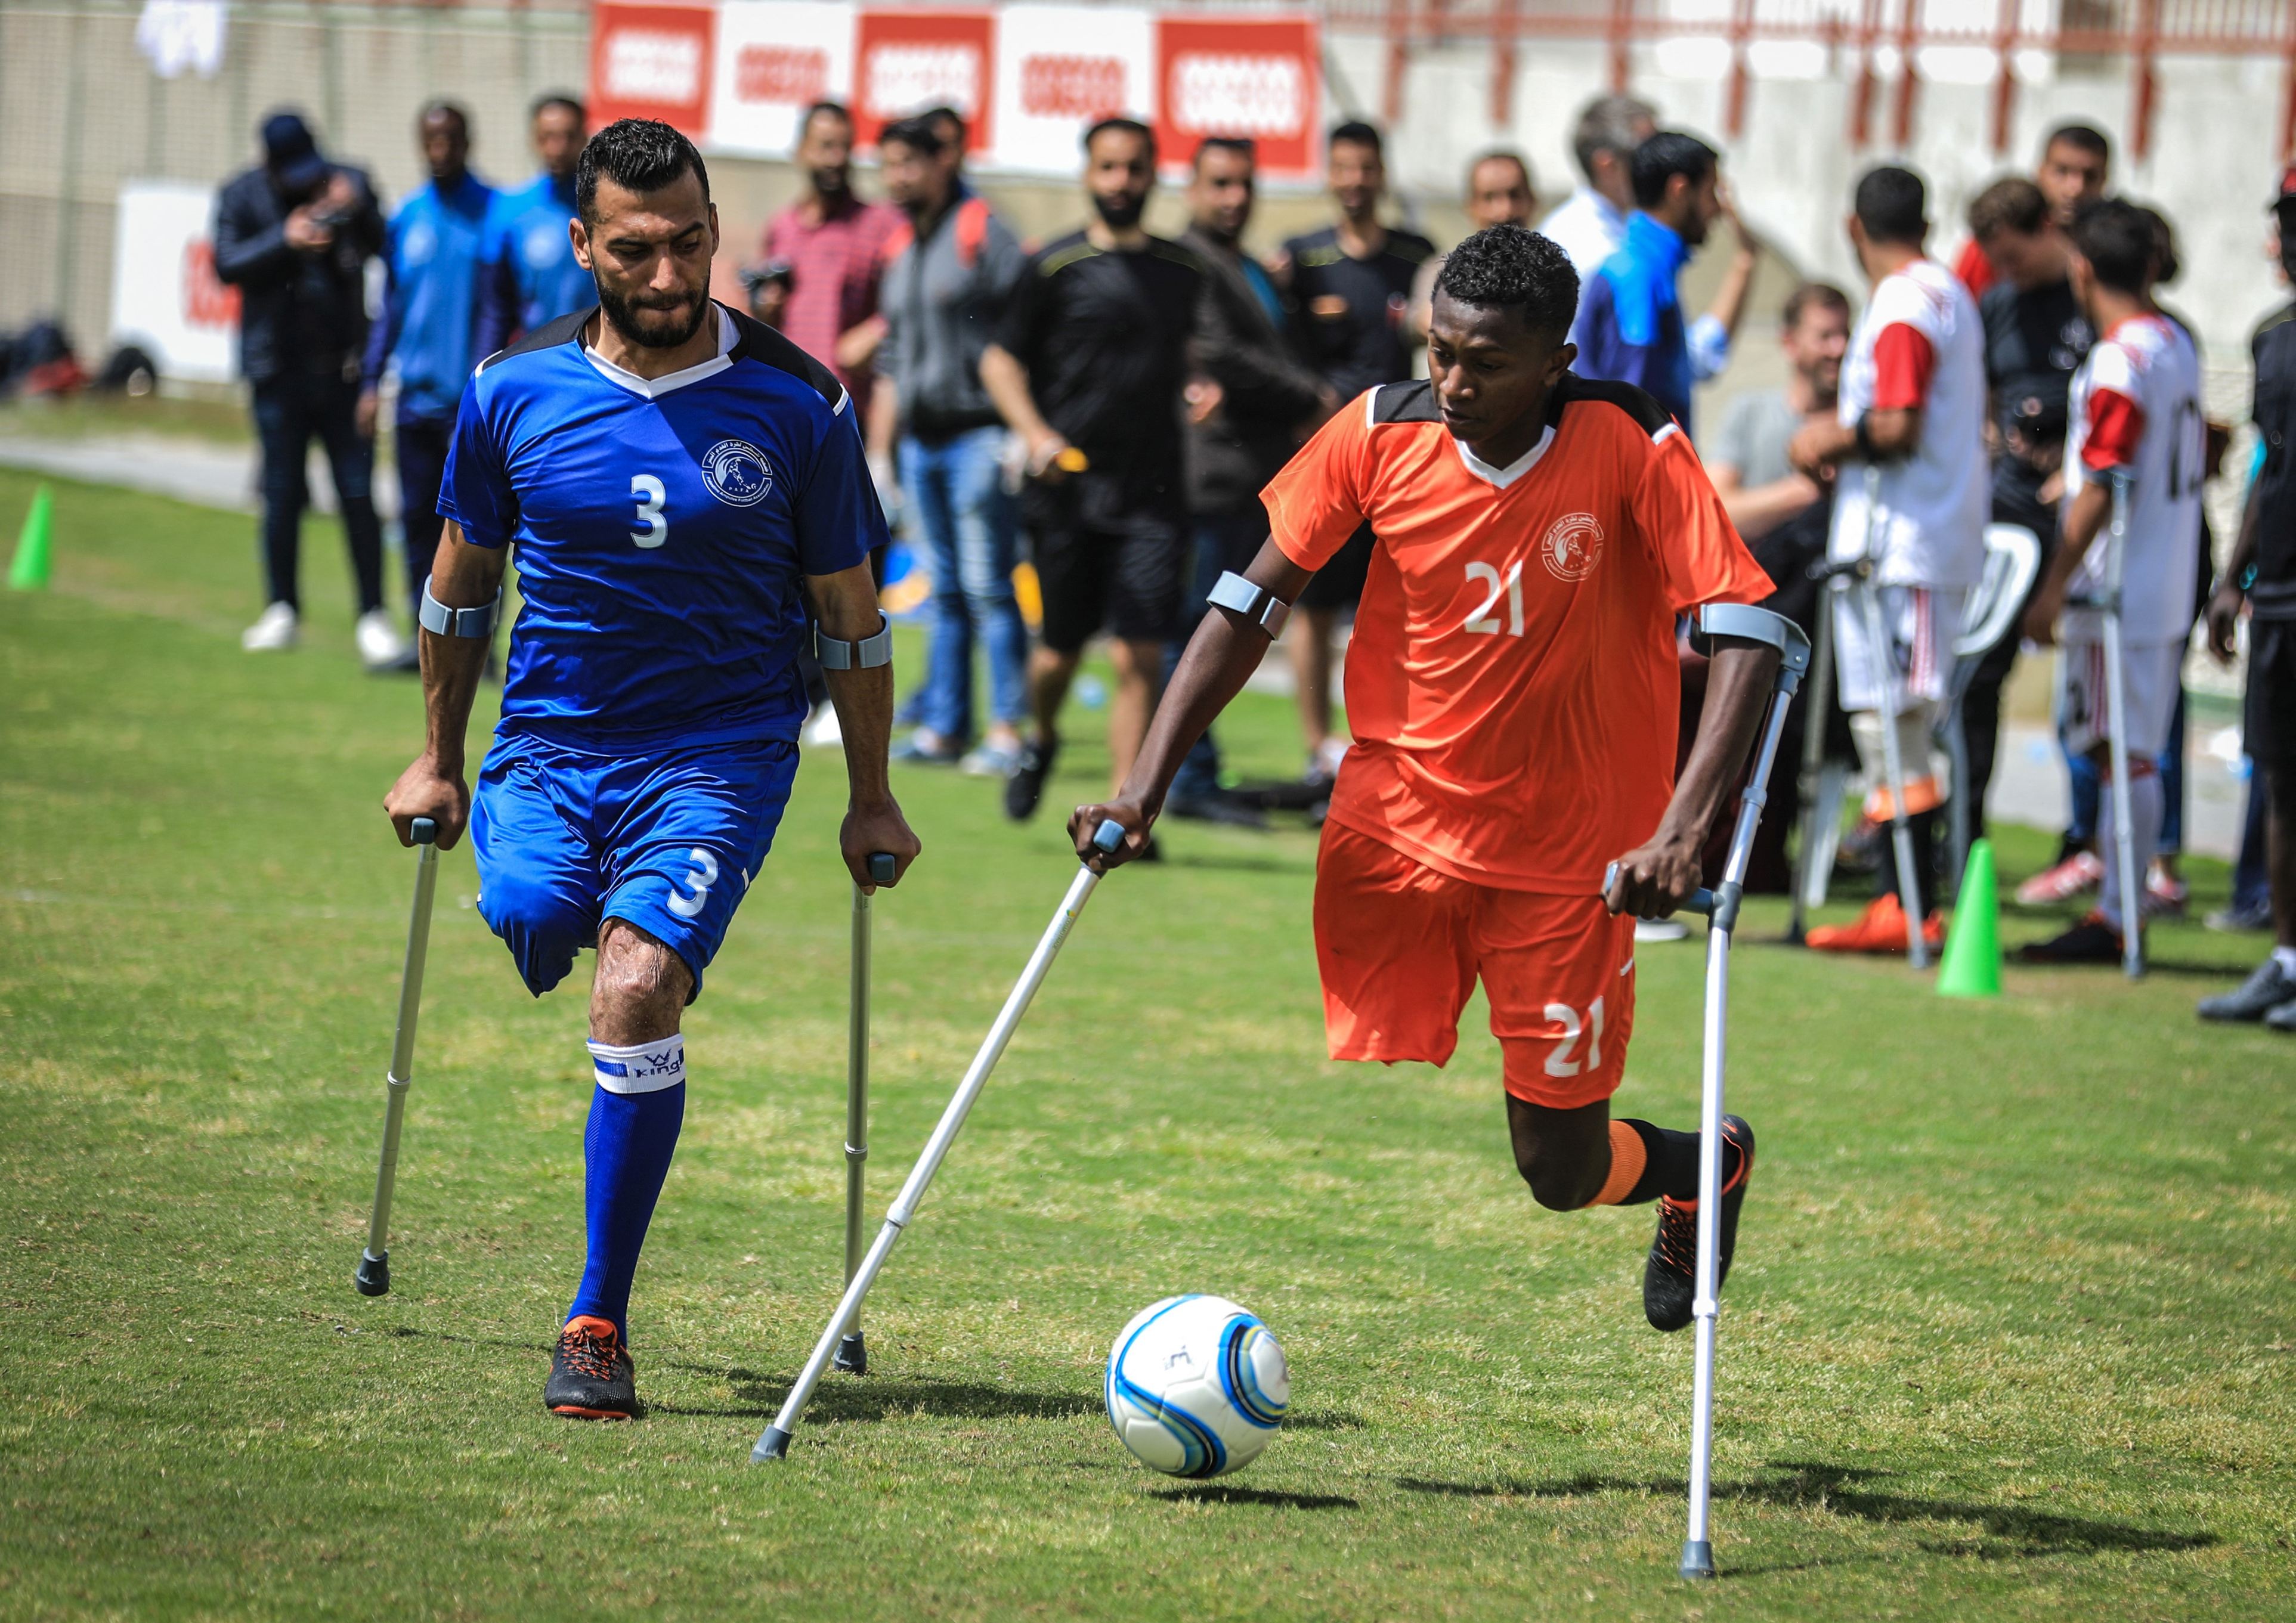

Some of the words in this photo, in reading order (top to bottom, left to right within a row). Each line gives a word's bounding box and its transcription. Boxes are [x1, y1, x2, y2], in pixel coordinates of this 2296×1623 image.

[630, 474, 668, 549] 3
[1464, 559, 1525, 637] 21
[667, 847, 718, 918] 3
[1543, 995, 1604, 1078] 21
